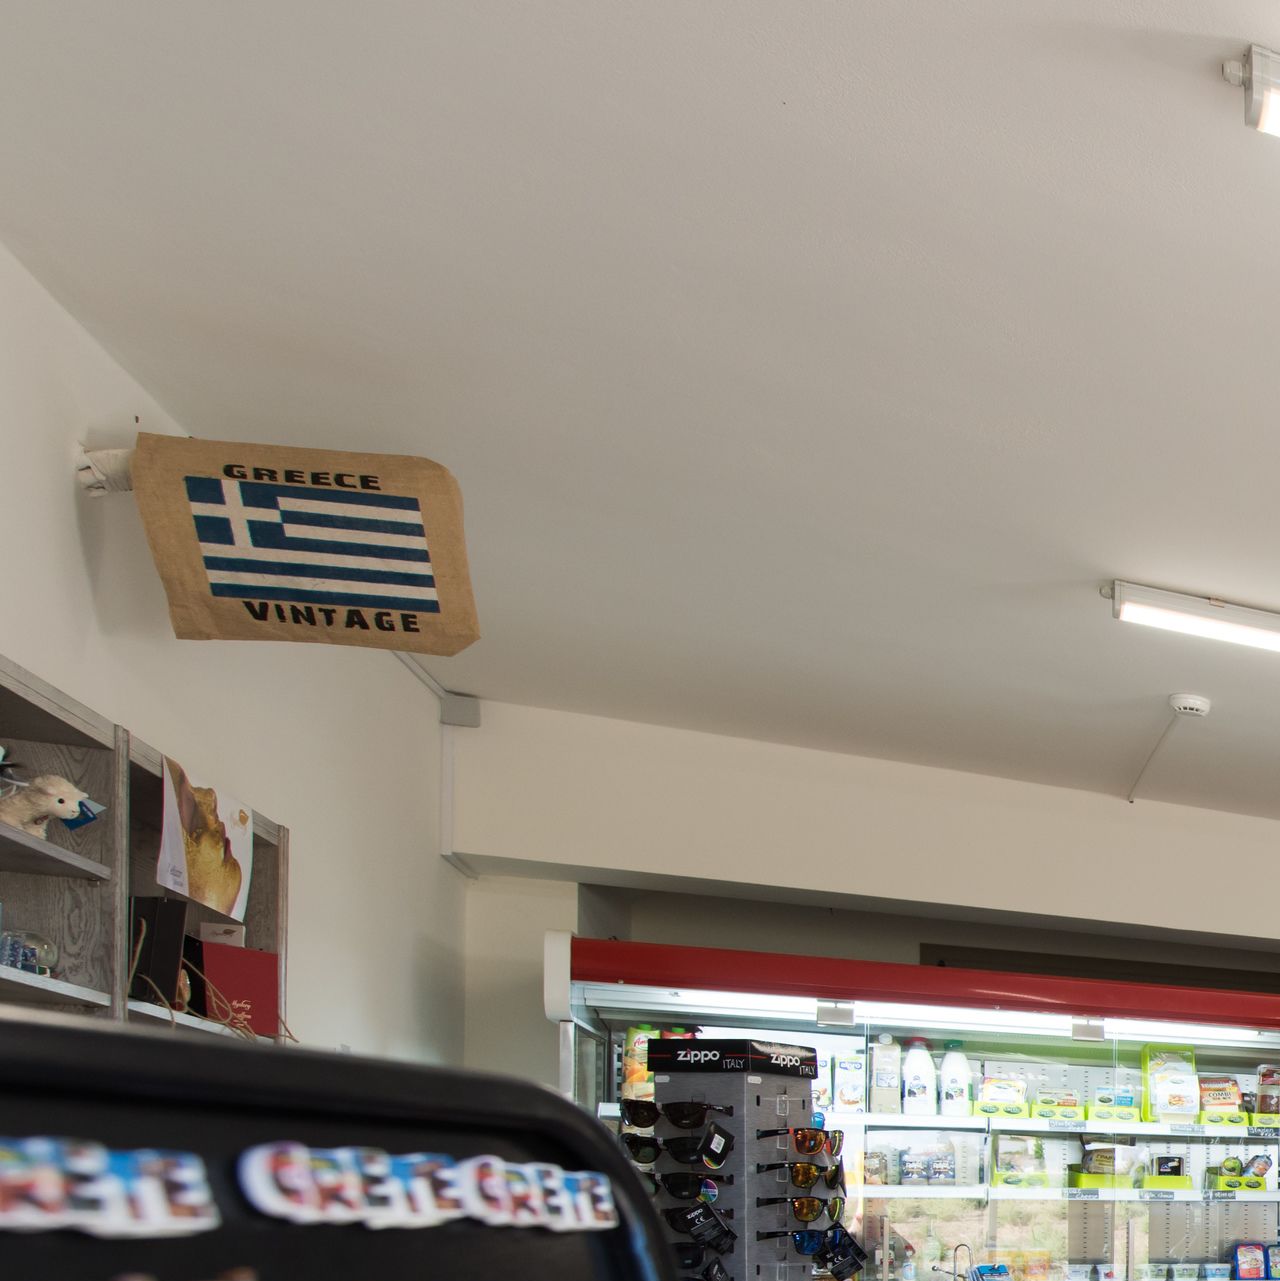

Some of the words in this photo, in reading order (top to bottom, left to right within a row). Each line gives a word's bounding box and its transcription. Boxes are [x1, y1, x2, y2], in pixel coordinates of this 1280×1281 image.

[223, 464, 382, 490] GREECE
[242, 601, 420, 632] VINTAGE
[723, 1058, 744, 1069] ITALY
